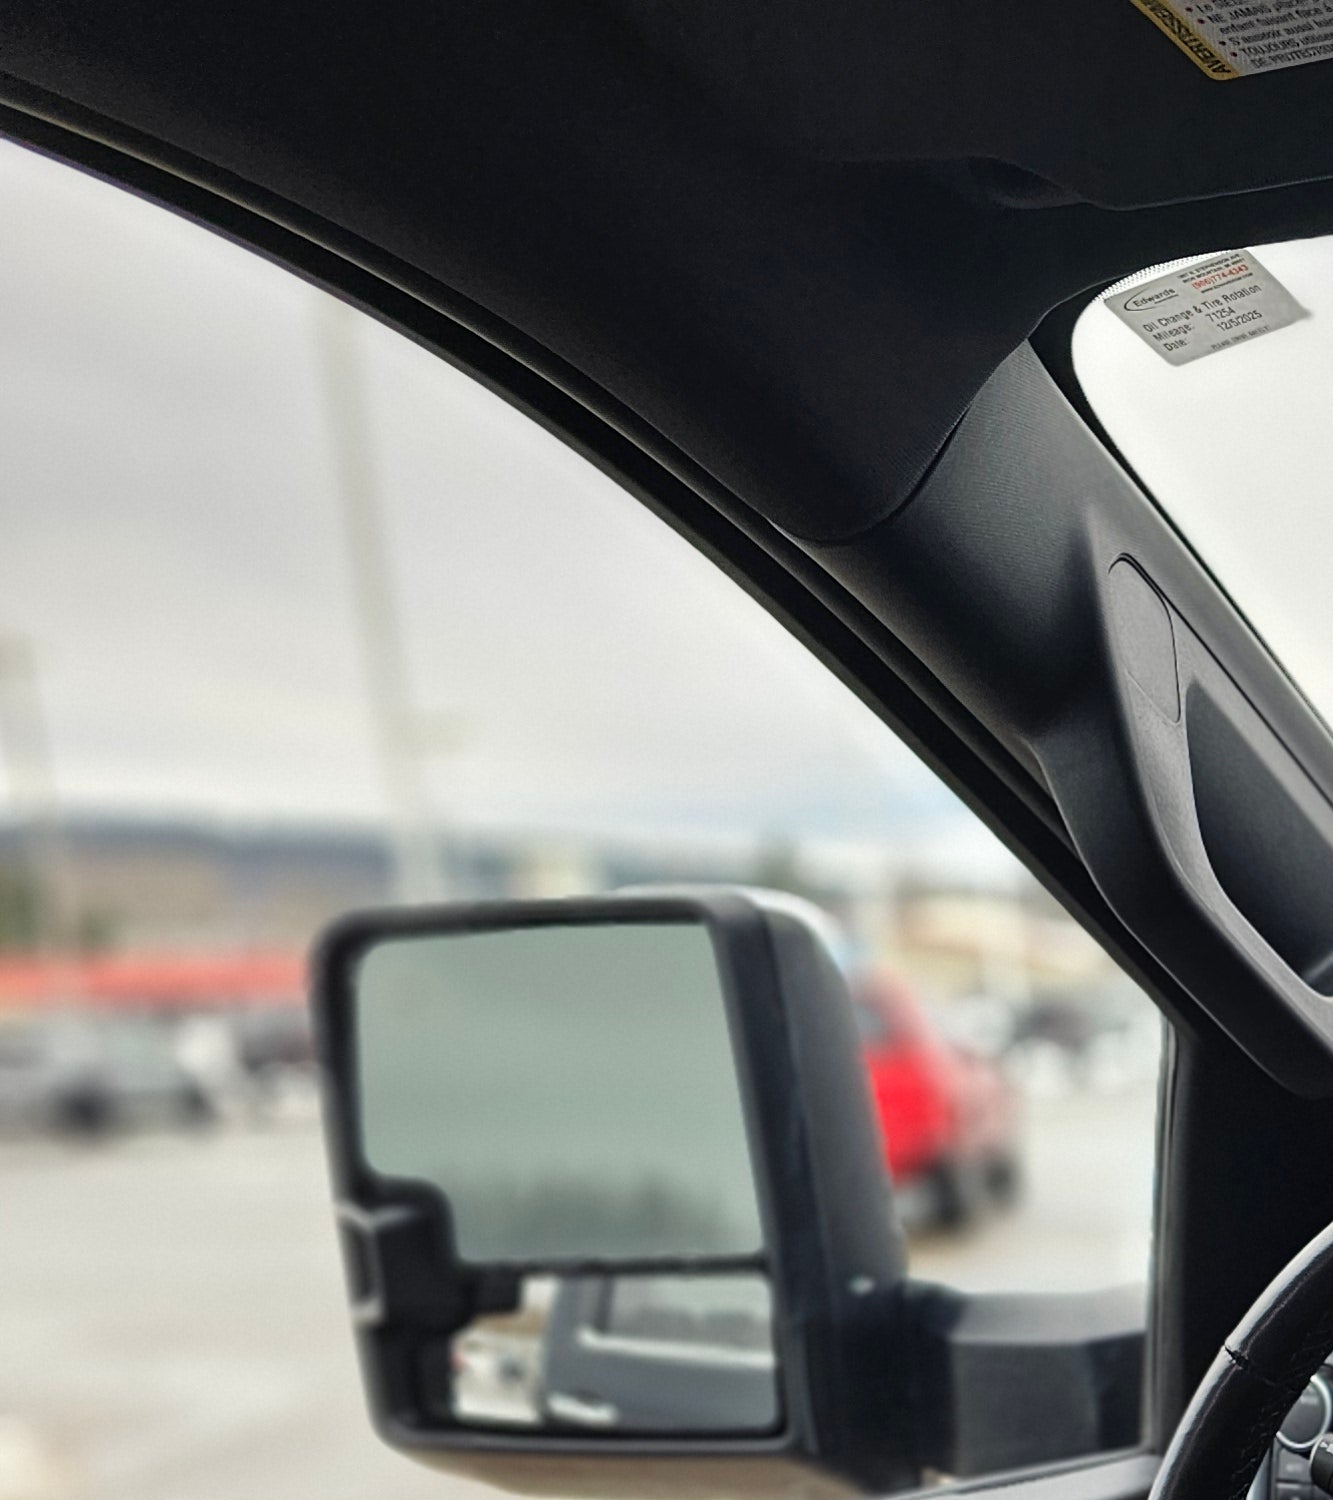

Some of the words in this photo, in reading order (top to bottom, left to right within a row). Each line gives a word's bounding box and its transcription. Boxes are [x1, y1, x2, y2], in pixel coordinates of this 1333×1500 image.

[1133, 288, 1176, 307] Edwards
[1143, 322, 1157, 333] Oil
[1158, 309, 1192, 330] Change
[1193, 305, 1202, 314] &
[1201, 298, 1223, 311] Tire
[1224, 284, 1262, 304] Rotation
[1205, 306, 1237, 323] 71254
